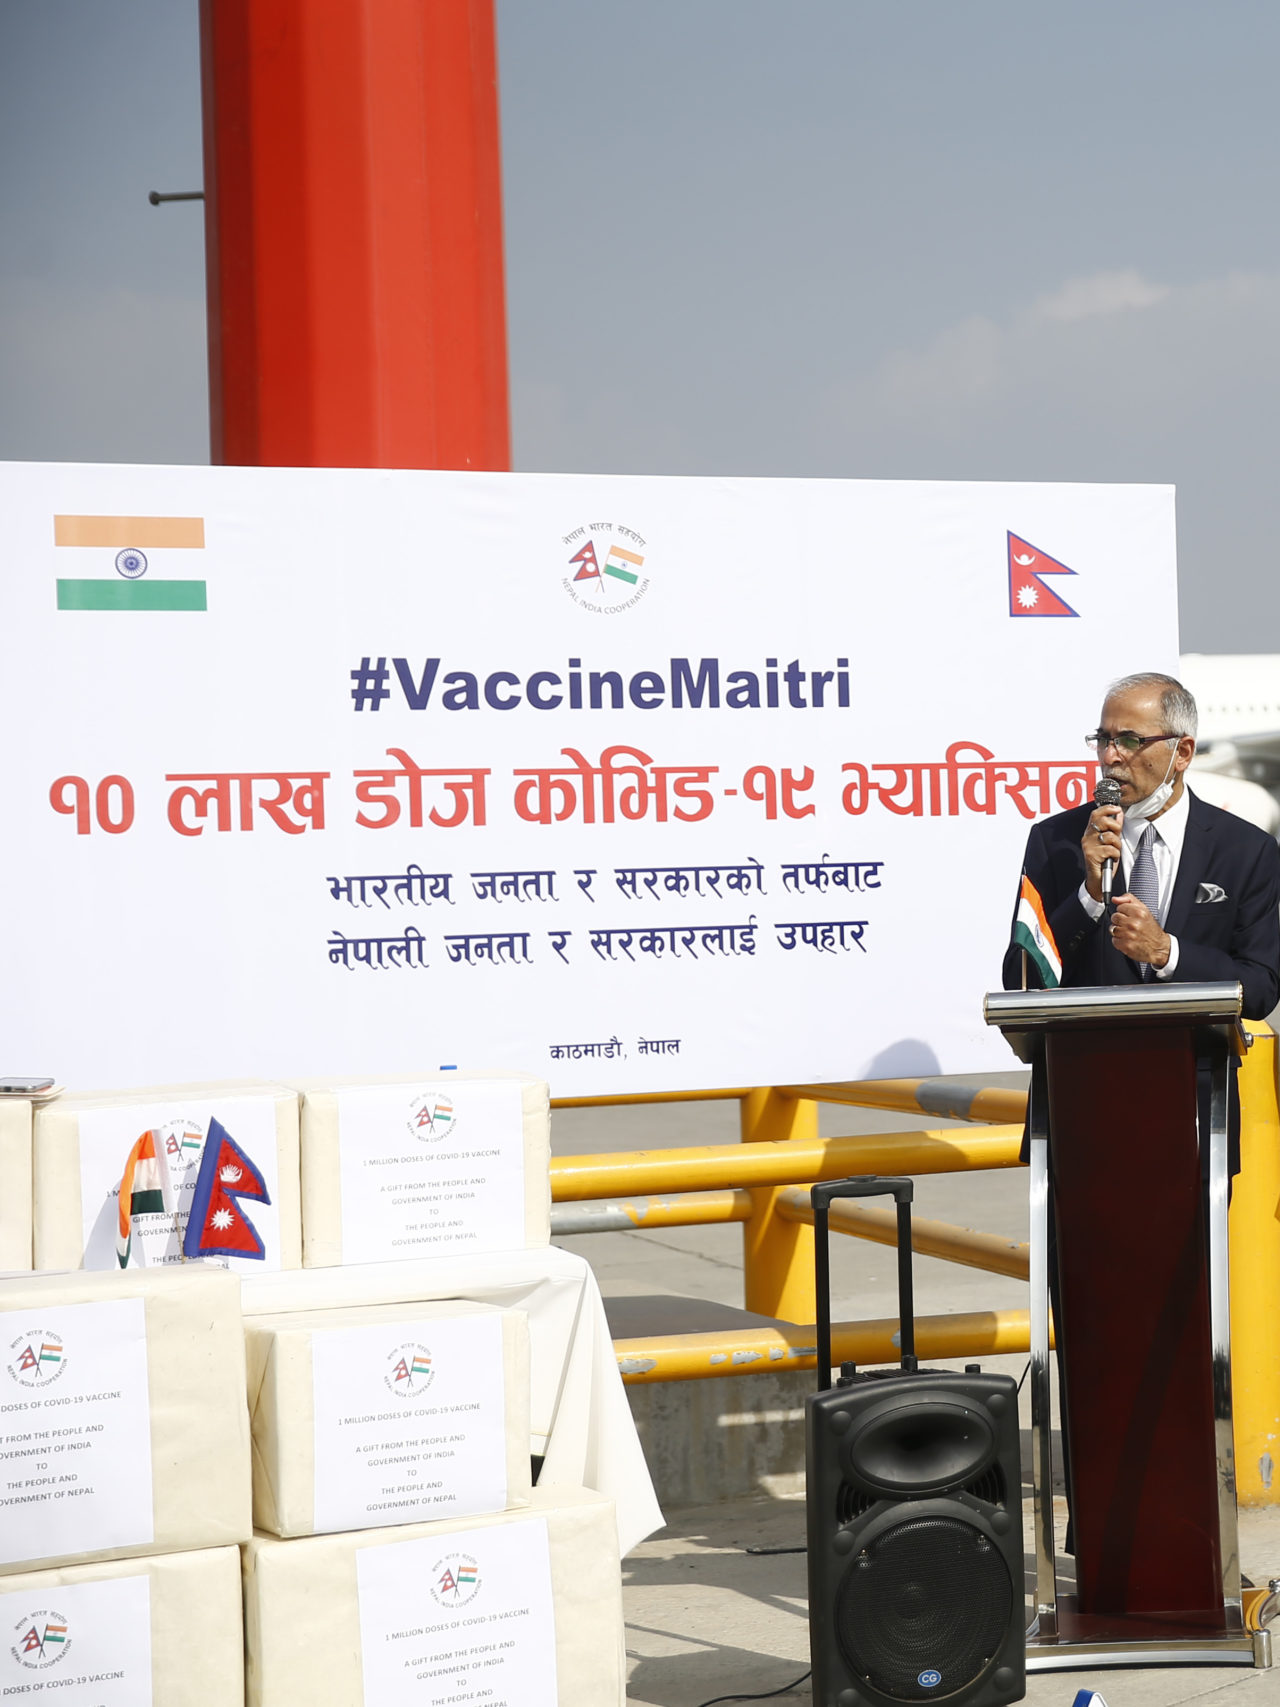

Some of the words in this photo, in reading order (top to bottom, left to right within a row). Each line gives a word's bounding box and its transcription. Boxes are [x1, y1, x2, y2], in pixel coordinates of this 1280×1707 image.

[589, 523, 613, 531] भारत
[561, 578, 579, 602] NEPAL
[579, 599, 602, 613] INDIA
[604, 578, 650, 615] COOPERATION
[351, 657, 850, 712] #VaccineMaitri
[49, 774, 135, 835] १०
[165, 771, 330, 836] लाख
[353, 747, 491, 829] डोज
[326, 864, 456, 909] भारतीय
[470, 870, 560, 903] जनता
[575, 869, 598, 902] र
[616, 856, 767, 902] सरकारको
[781, 853, 885, 895] तर्फबाट
[327, 926, 430, 971] नेपाली
[444, 932, 534, 966] जनता
[548, 931, 572, 964] र
[590, 915, 758, 962] सरकारलाई
[775, 920, 869, 953] उपहार
[638, 1036, 681, 1055] नेपाल
[369, 1158, 399, 1166] MILLION
[436, 1152, 469, 1160] COVID-19
[472, 1149, 500, 1157] VACCINE
[392, 1195, 442, 1205] GOVERNMENT
[133, 1215, 149, 1223] GIFT
[151, 1213, 175, 1221] FROM
[392, 1236, 442, 1246] GOVERNMENT
[1, 1403, 28, 1412] DOSES
[30, 1401, 41, 1409] OF
[44, 1396, 83, 1407] COVID-19
[86, 1391, 121, 1402] VACCINE
[344, 1416, 375, 1425] MILLION
[378, 1412, 400, 1421] DOSES
[415, 1407, 448, 1416] COVID-19
[450, 1403, 480, 1412] VACCINE
[6, 1434, 31, 1443] FROM
[34, 1431, 50, 1439] THE
[52, 1427, 82, 1437] PEOPLE
[86, 1425, 104, 1433] AND
[363, 1444, 379, 1452] GIFT
[381, 1442, 403, 1450] FROM
[421, 1437, 447, 1445] PEOPLE
[450, 1434, 465, 1442] AND
[0, 1446, 52, 1460] OVERNMENT
[68, 1442, 91, 1451] INDIA
[368, 1454, 420, 1467] GOVERNMENT
[7, 1481, 22, 1489] THE
[25, 1477, 56, 1487] PEOPLE
[59, 1474, 77, 1482] AND
[397, 1483, 424, 1493] PEOPLE
[427, 1481, 442, 1489] AND
[0, 1493, 52, 1506] OVERNMENT
[68, 1487, 94, 1497] NEPAL
[367, 1499, 419, 1511] GOVERNMENT
[433, 1494, 456, 1503] NEPAL
[392, 1629, 423, 1640] MILLION
[425, 1623, 449, 1634] DOSES
[463, 1614, 497, 1626] COVID-19
[499, 1608, 529, 1619] VACCINE
[412, 1658, 427, 1666] GIFT
[430, 1653, 452, 1662] FROM
[455, 1649, 467, 1658] THE
[470, 1645, 496, 1654] PEOPLE
[499, 1641, 515, 1649] AND
[417, 1664, 470, 1680] GOVERNMENT
[484, 1658, 504, 1666] INDIA
[3, 1685, 31, 1695] DOSES
[33, 1682, 45, 1690] OF
[47, 1677, 86, 1688] COVID-19
[89, 1671, 124, 1682] VACCINE
[922, 1674, 937, 1683] CG
[447, 1693, 474, 1703] PEOPLE
[477, 1689, 493, 1697] AND
